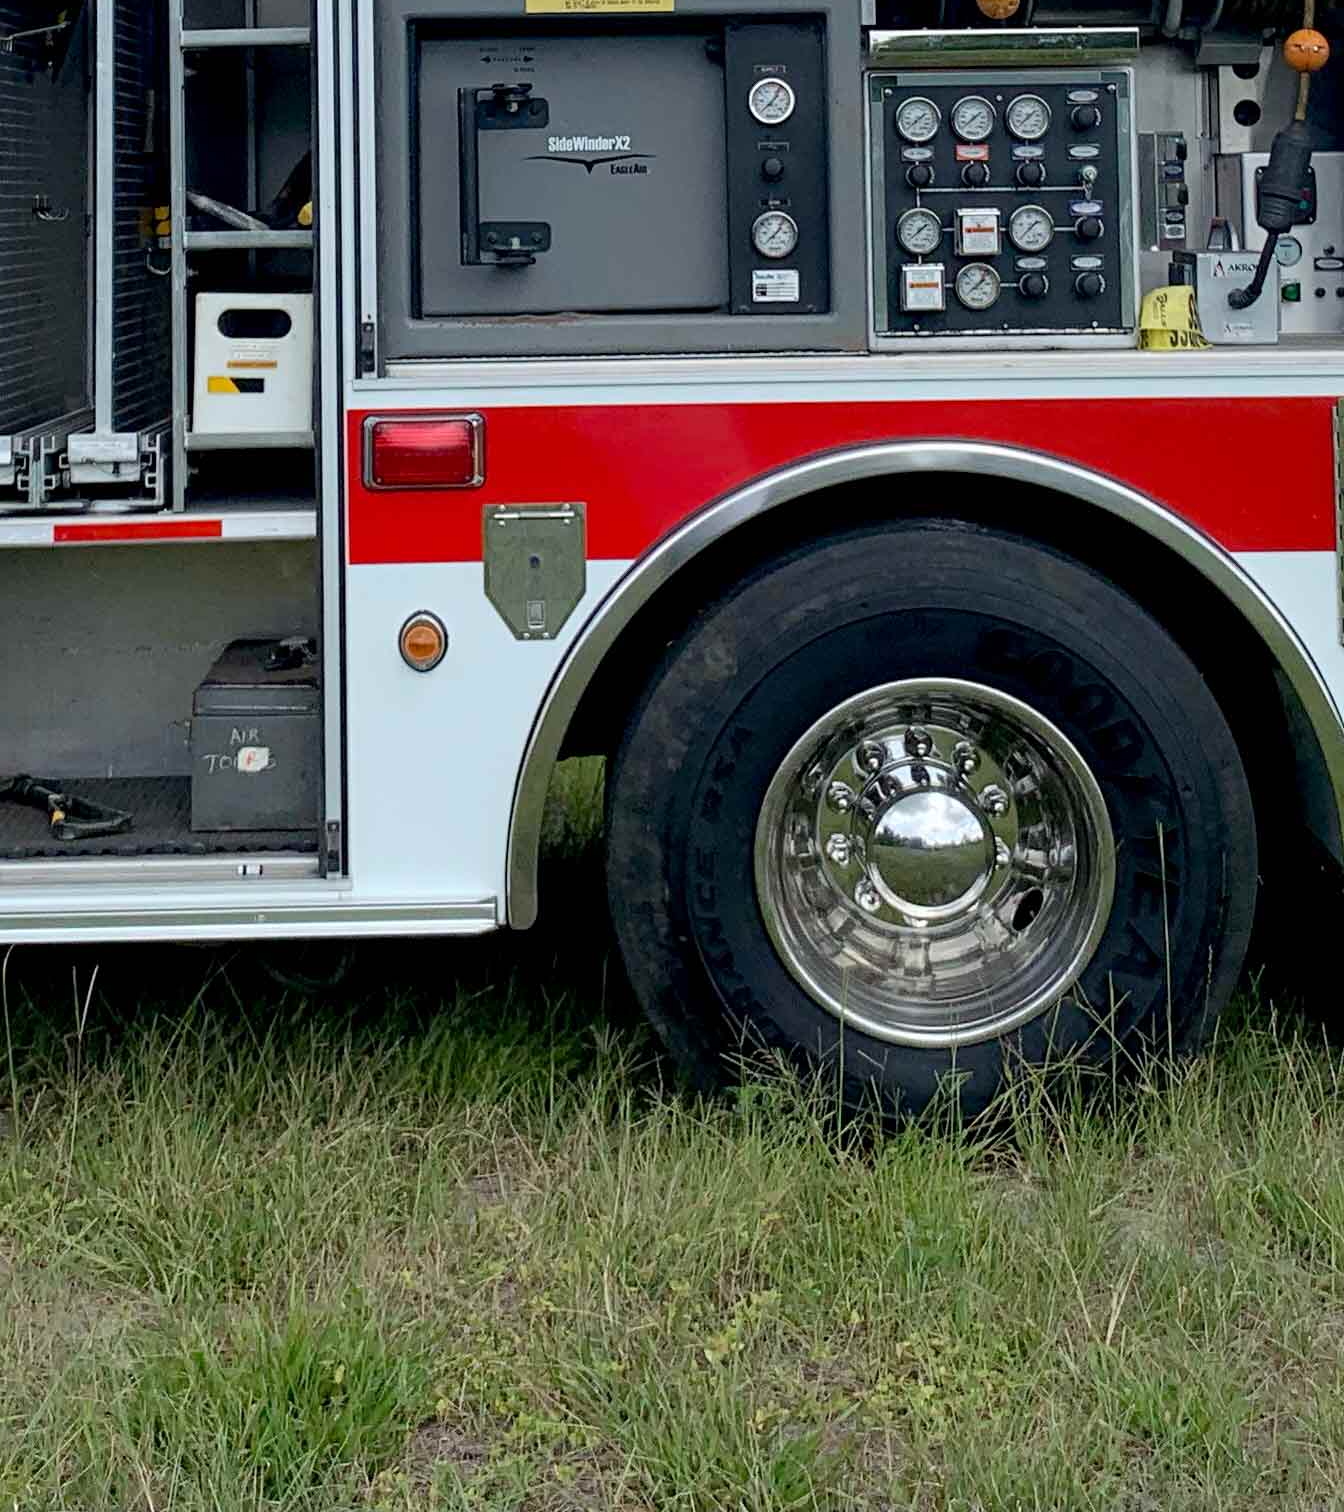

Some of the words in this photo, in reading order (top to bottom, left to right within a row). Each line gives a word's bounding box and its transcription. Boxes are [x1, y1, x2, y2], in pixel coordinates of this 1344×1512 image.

[1227, 263, 1257, 272] AKRO
[230, 727, 260, 744] AIR
[202, 754, 276, 774] TOS
